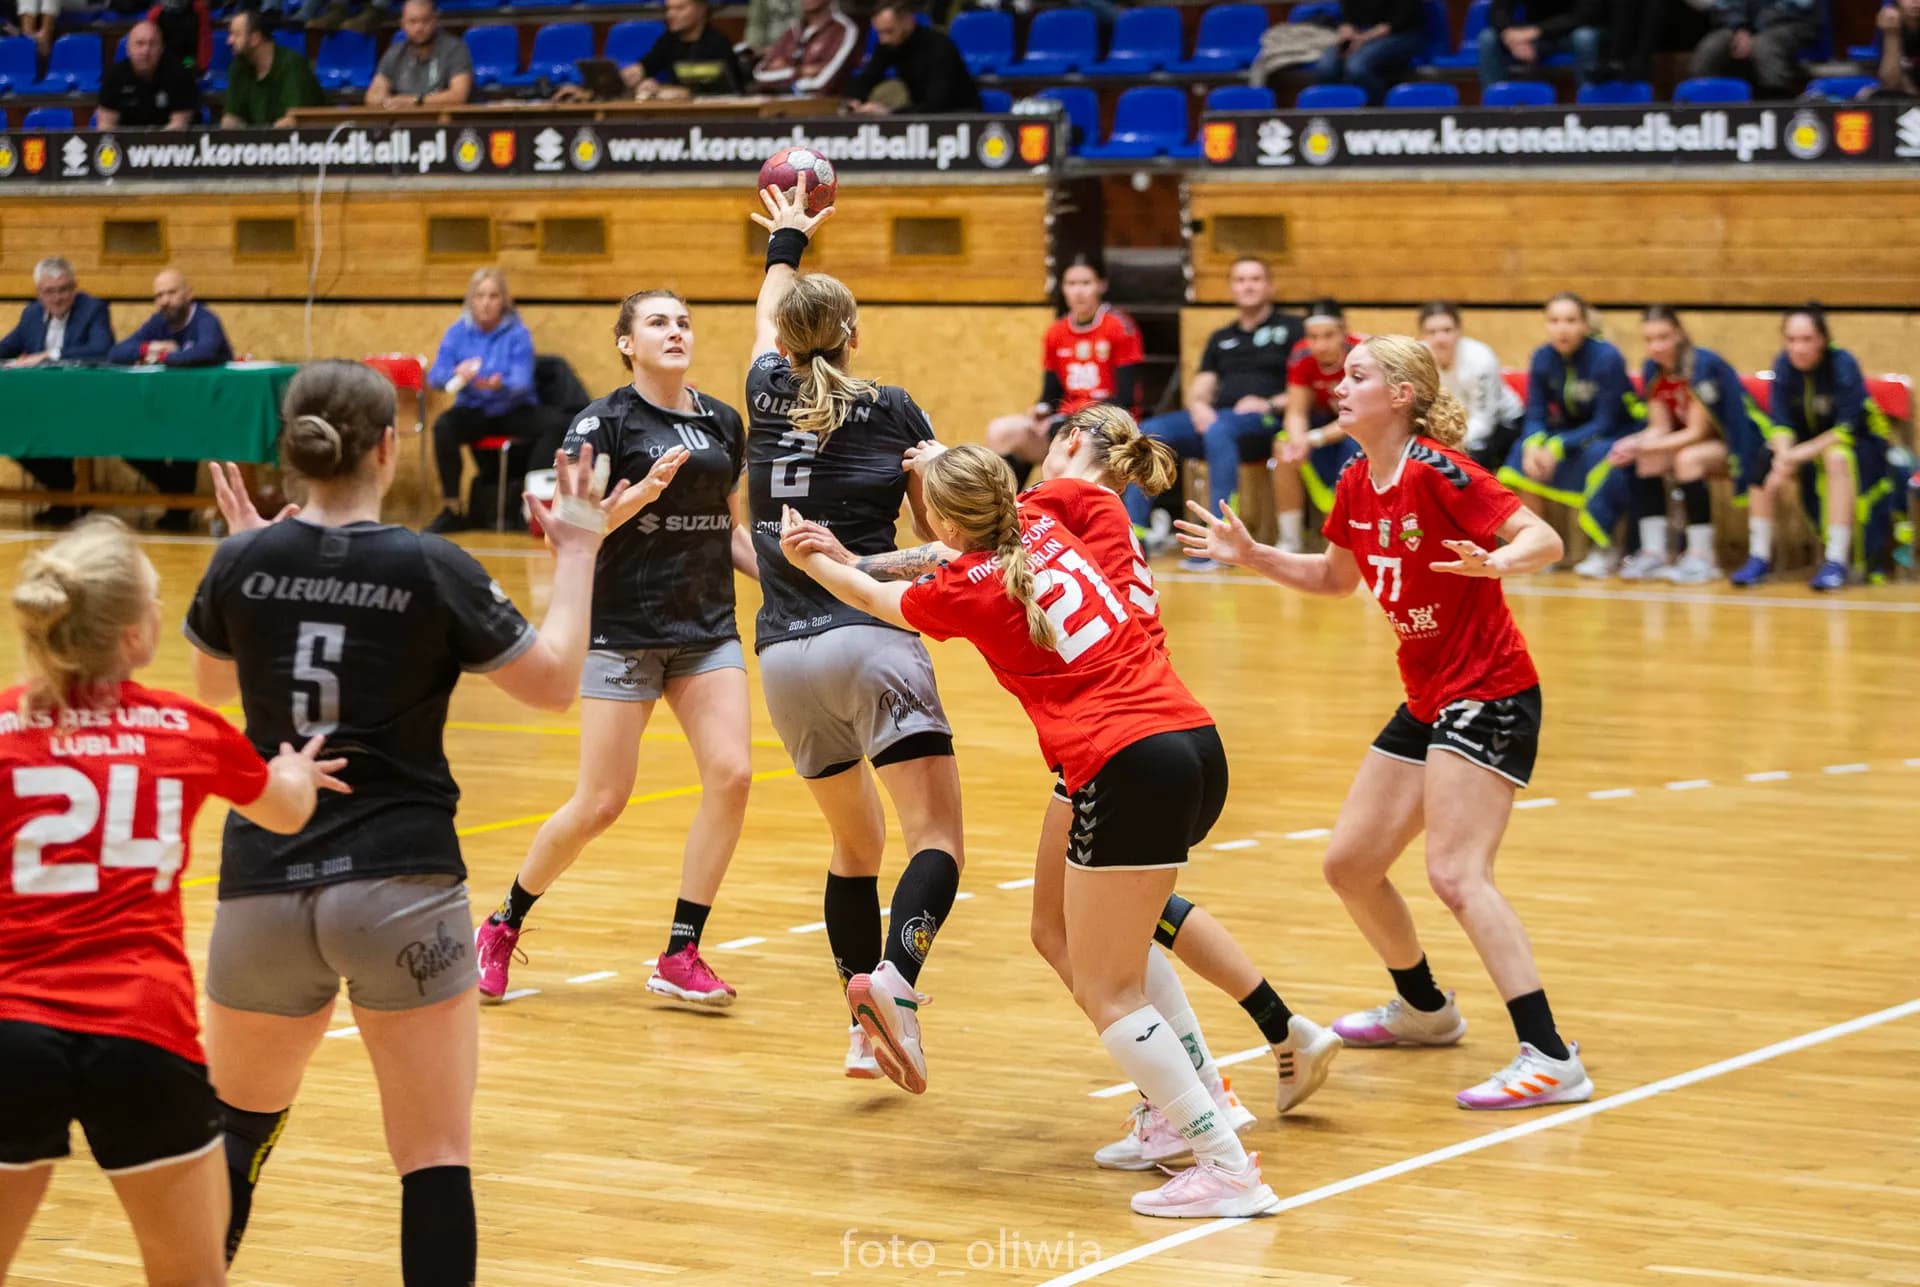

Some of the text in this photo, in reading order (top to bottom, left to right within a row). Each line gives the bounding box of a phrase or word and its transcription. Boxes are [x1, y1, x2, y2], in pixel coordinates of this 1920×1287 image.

[128, 129, 446, 172] www.koronahandball.pl
[1345, 112, 1776, 161] www.koronahandball.pl
[673, 423, 710, 451] 10
[770, 430, 818, 498] 2
[665, 514, 732, 532] SUZUK
[274, 576, 412, 613] LEWIATAN
[1367, 555, 1402, 602] 77
[1034, 548, 1128, 665] 21
[292, 621, 346, 737] 5
[116, 706, 190, 731] UMCS
[51, 734, 146, 757] LUBLIN
[12, 763, 185, 895] 24
